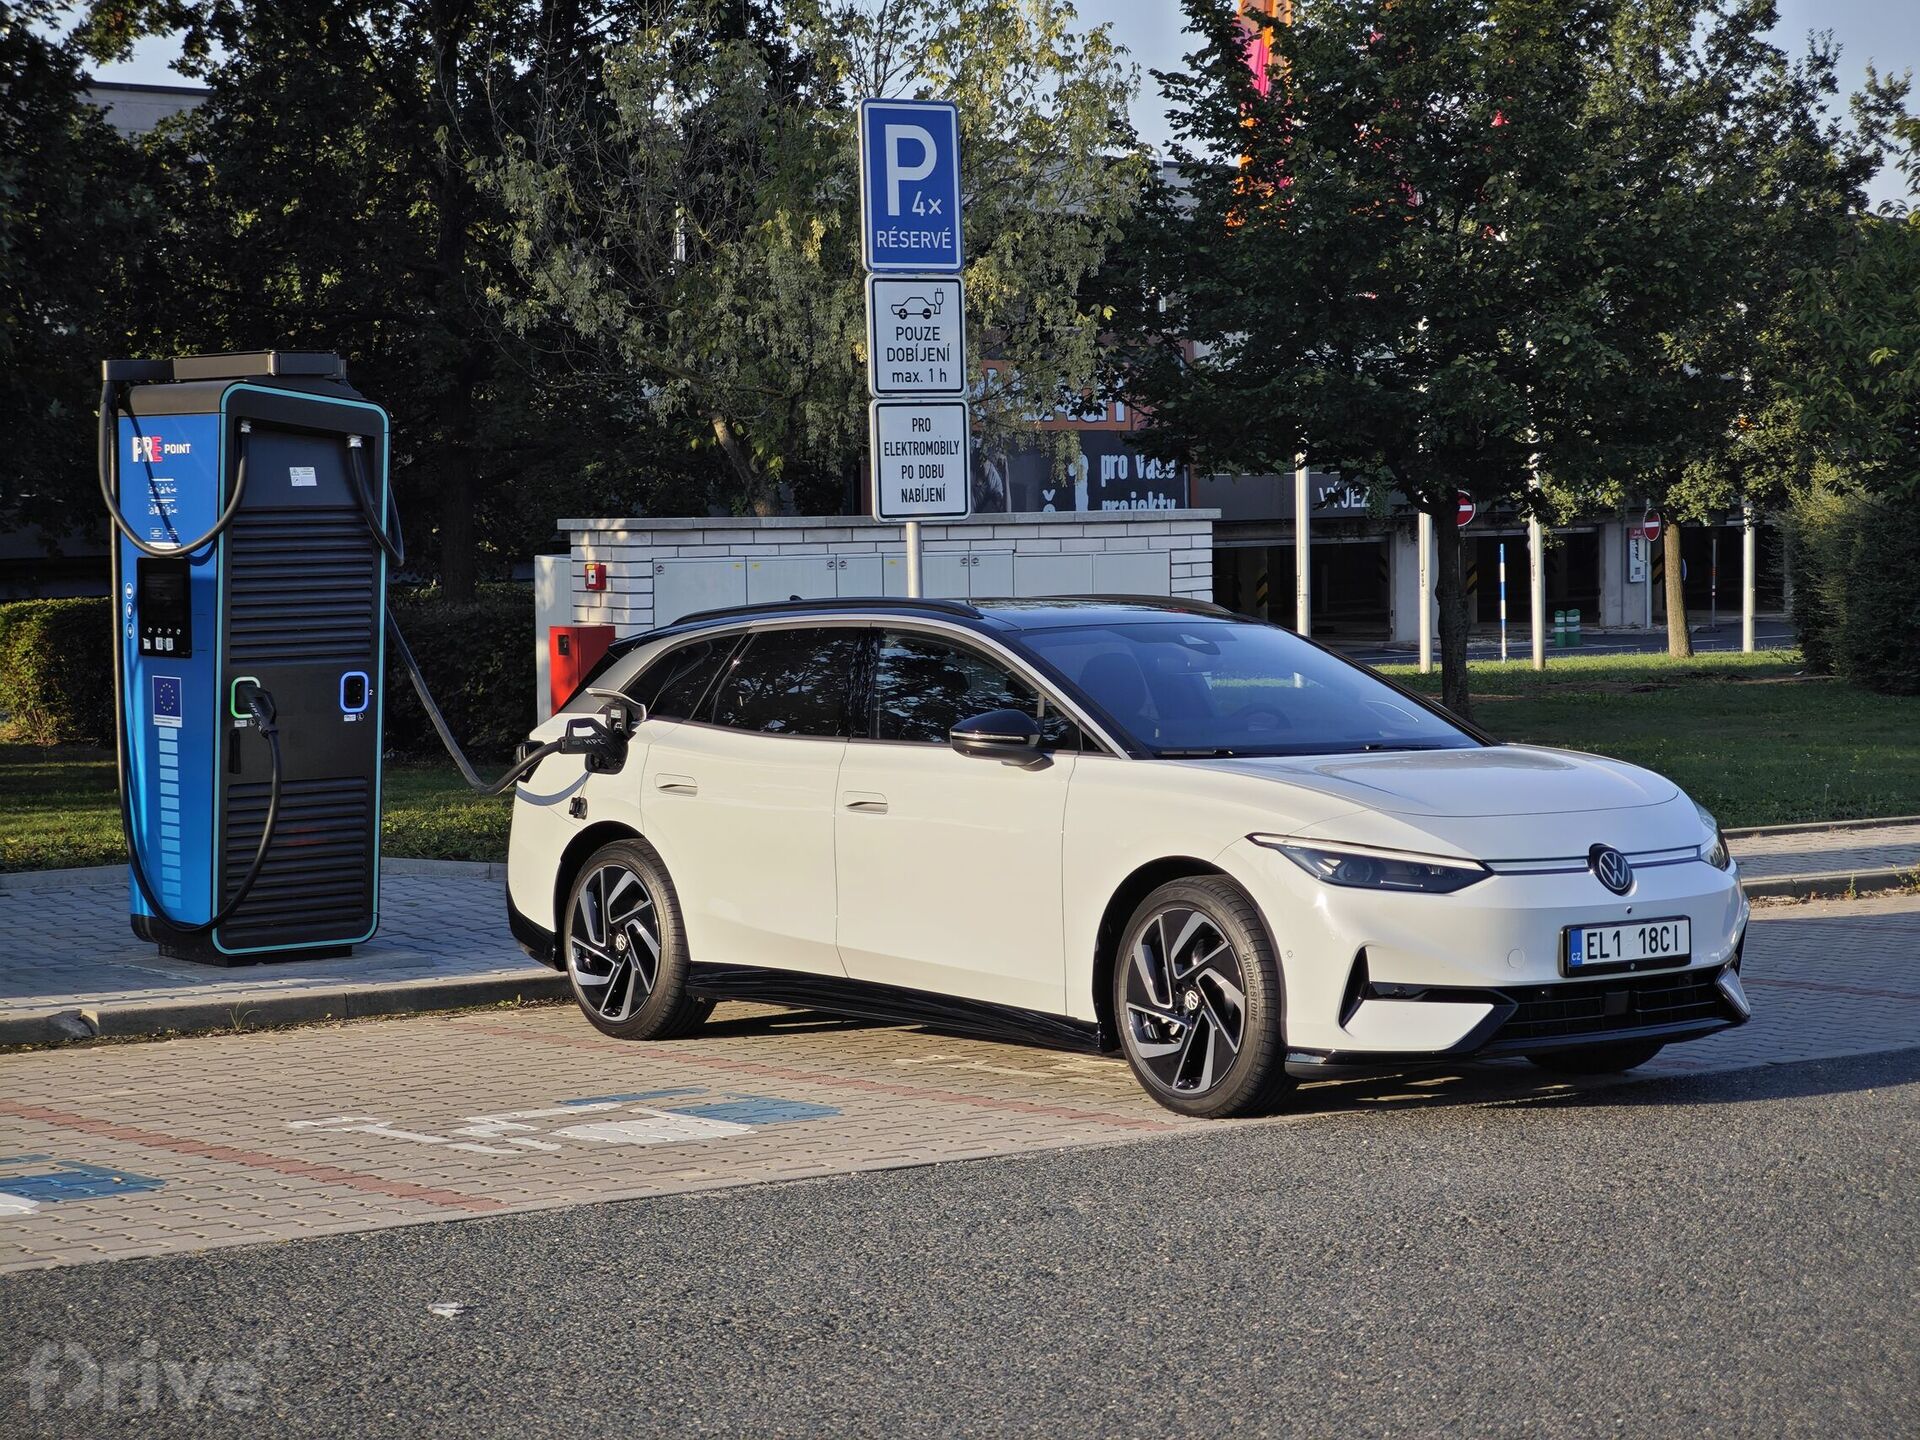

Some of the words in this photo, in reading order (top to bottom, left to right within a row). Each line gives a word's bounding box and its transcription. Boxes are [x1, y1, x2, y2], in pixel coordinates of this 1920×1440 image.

[885, 124, 937, 216] P
[876, 226, 952, 249] RÉSERVÉ
[895, 326, 941, 341] POUZE
[886, 342, 950, 362] DOBÍJENÍ
[891, 371, 923, 383] max.
[929, 367, 934, 383] 1
[939, 367, 947, 383] h
[911, 417, 931, 432] PRO
[132, 436, 163, 463] PRE
[164, 443, 191, 454] POINT
[883, 440, 960, 457] ELEKTROMOBILY
[901, 465, 914, 479] PO
[918, 464, 944, 479] DOBU
[1100, 454, 1128, 487] pro
[901, 483, 946, 503] NABÍJENÍ
[1587, 930, 1621, 960] EL1
[1638, 924, 1678, 954] 18CI
[1571, 952, 1581, 961] CZ
